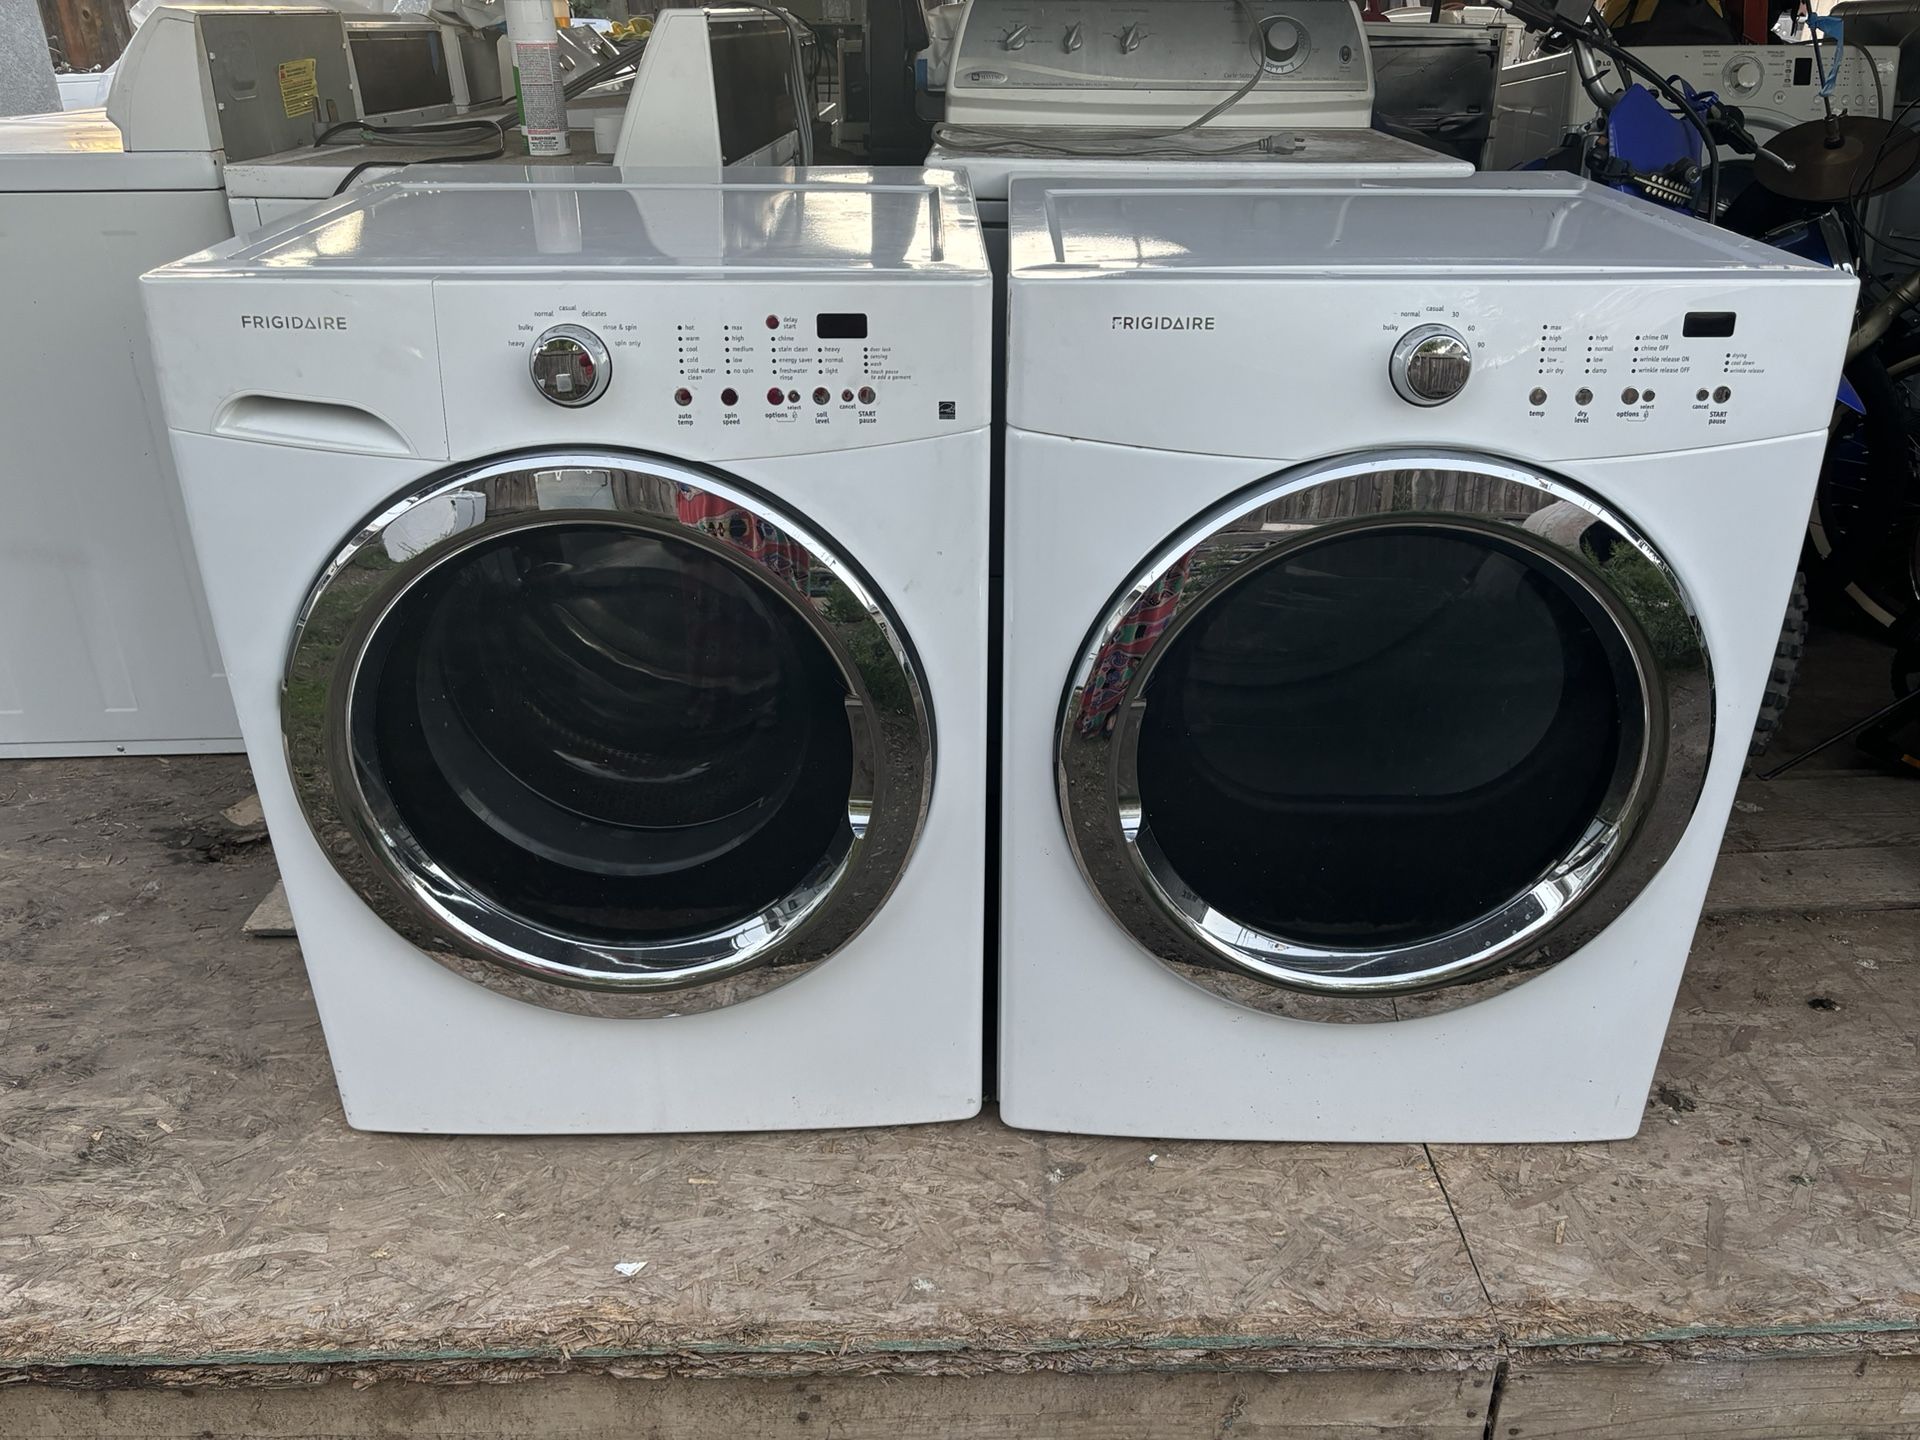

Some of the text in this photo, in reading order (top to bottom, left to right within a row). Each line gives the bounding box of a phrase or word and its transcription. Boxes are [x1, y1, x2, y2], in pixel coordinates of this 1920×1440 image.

[241, 315, 347, 330] FRIGIDAIRE
[1112, 316, 1215, 330] FRIGIDAIRE
[508, 340, 525, 348] heavy
